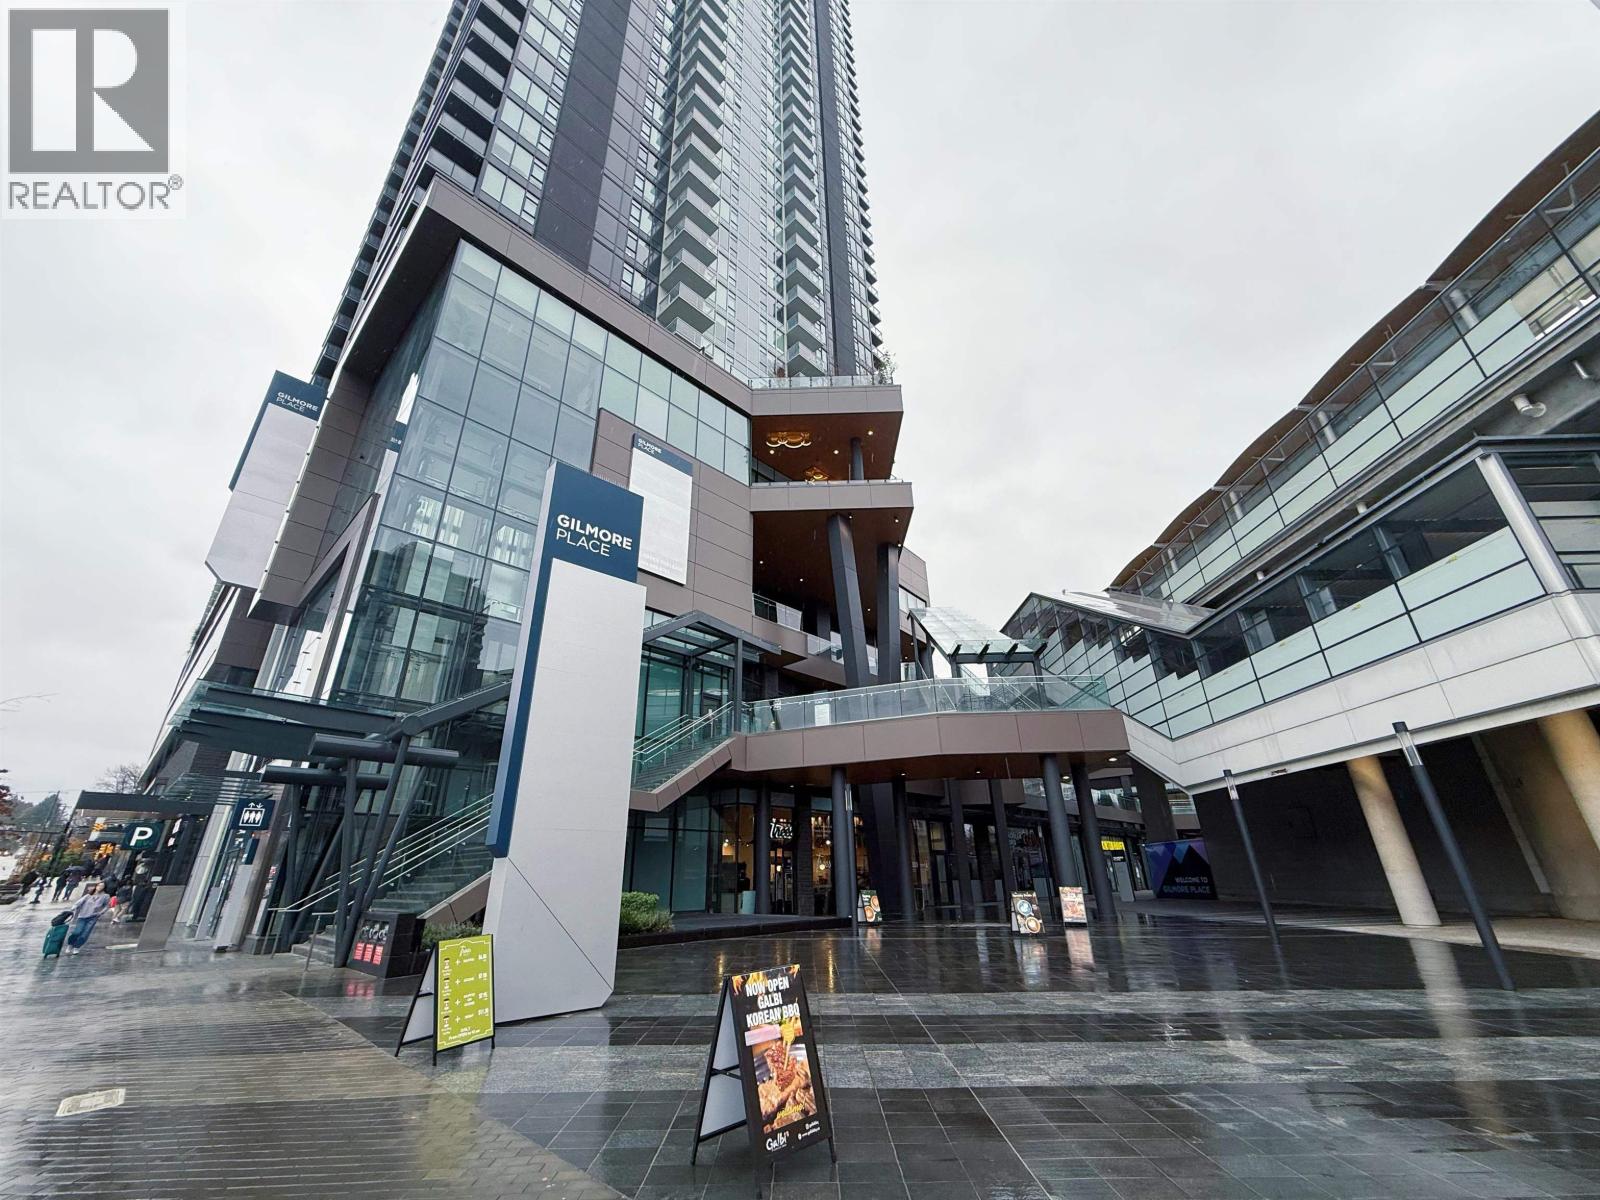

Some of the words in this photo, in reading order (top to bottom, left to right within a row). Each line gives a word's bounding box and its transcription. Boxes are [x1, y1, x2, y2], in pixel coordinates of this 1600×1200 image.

[276, 396, 305, 413] PLACE
[277, 392, 319, 412] GILMORE
[638, 438, 662, 454] GILMORE
[556, 528, 611, 557] PLACE
[557, 514, 633, 551] GILMORE
[129, 826, 153, 847] P
[745, 981, 766, 997] NOW
[767, 976, 790, 992] OPEN
[757, 991, 783, 1009] GALBI
[746, 1006, 781, 1028] KOREAN
[781, 1002, 800, 1019] BBQ
[766, 1131, 788, 1150] Galbi
